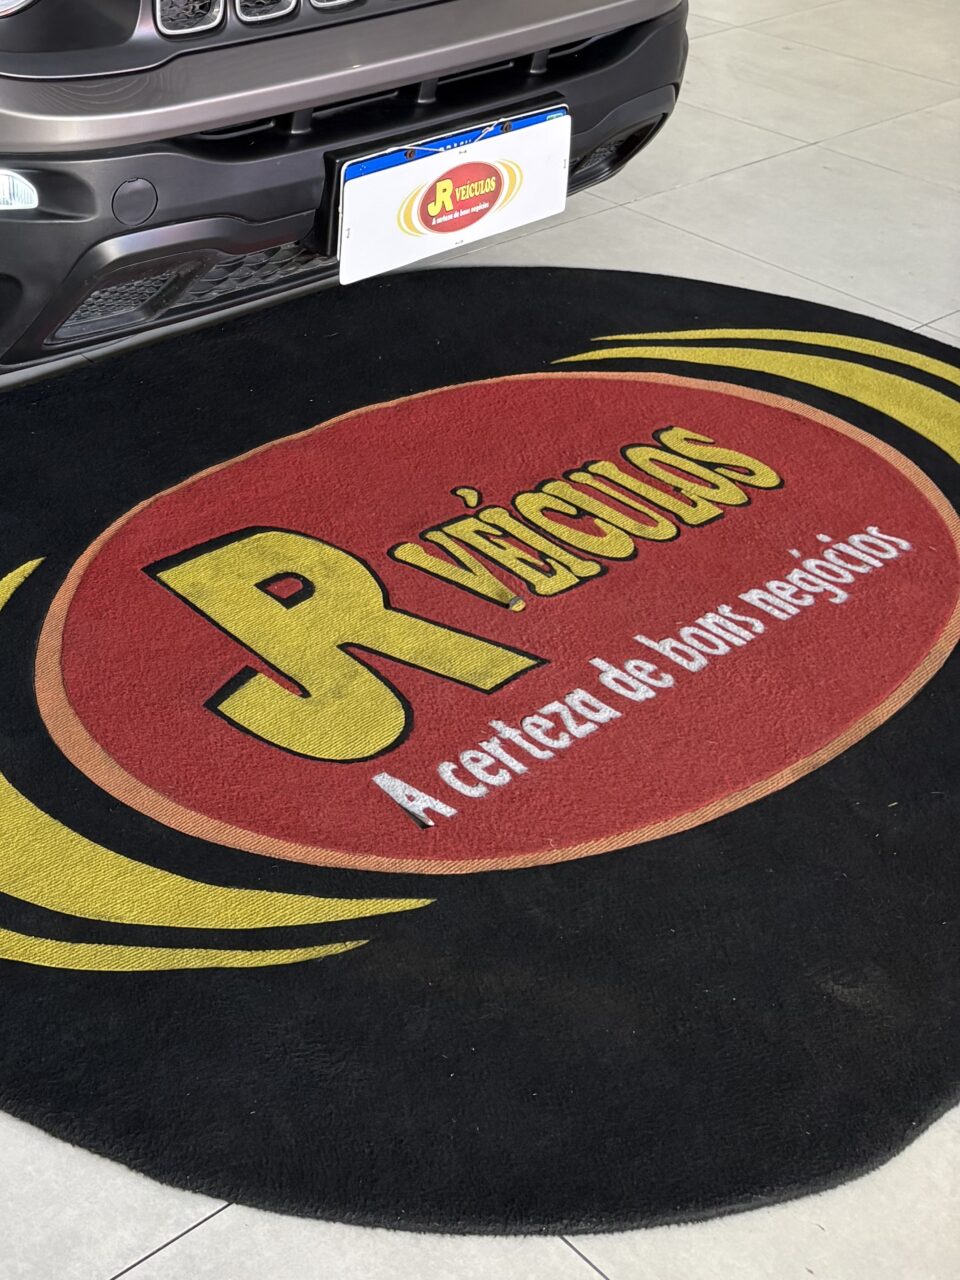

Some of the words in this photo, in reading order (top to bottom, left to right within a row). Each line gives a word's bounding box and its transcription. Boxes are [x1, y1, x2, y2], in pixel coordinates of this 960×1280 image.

[455, 176, 496, 202] VEÍCULOS
[389, 425, 784, 612] VEÍCULOS
[372, 770, 457, 829] A
[437, 688, 621, 798] certeza
[589, 656, 674, 703] de
[633, 604, 765, 674] bons
[738, 524, 913, 622] negócios
